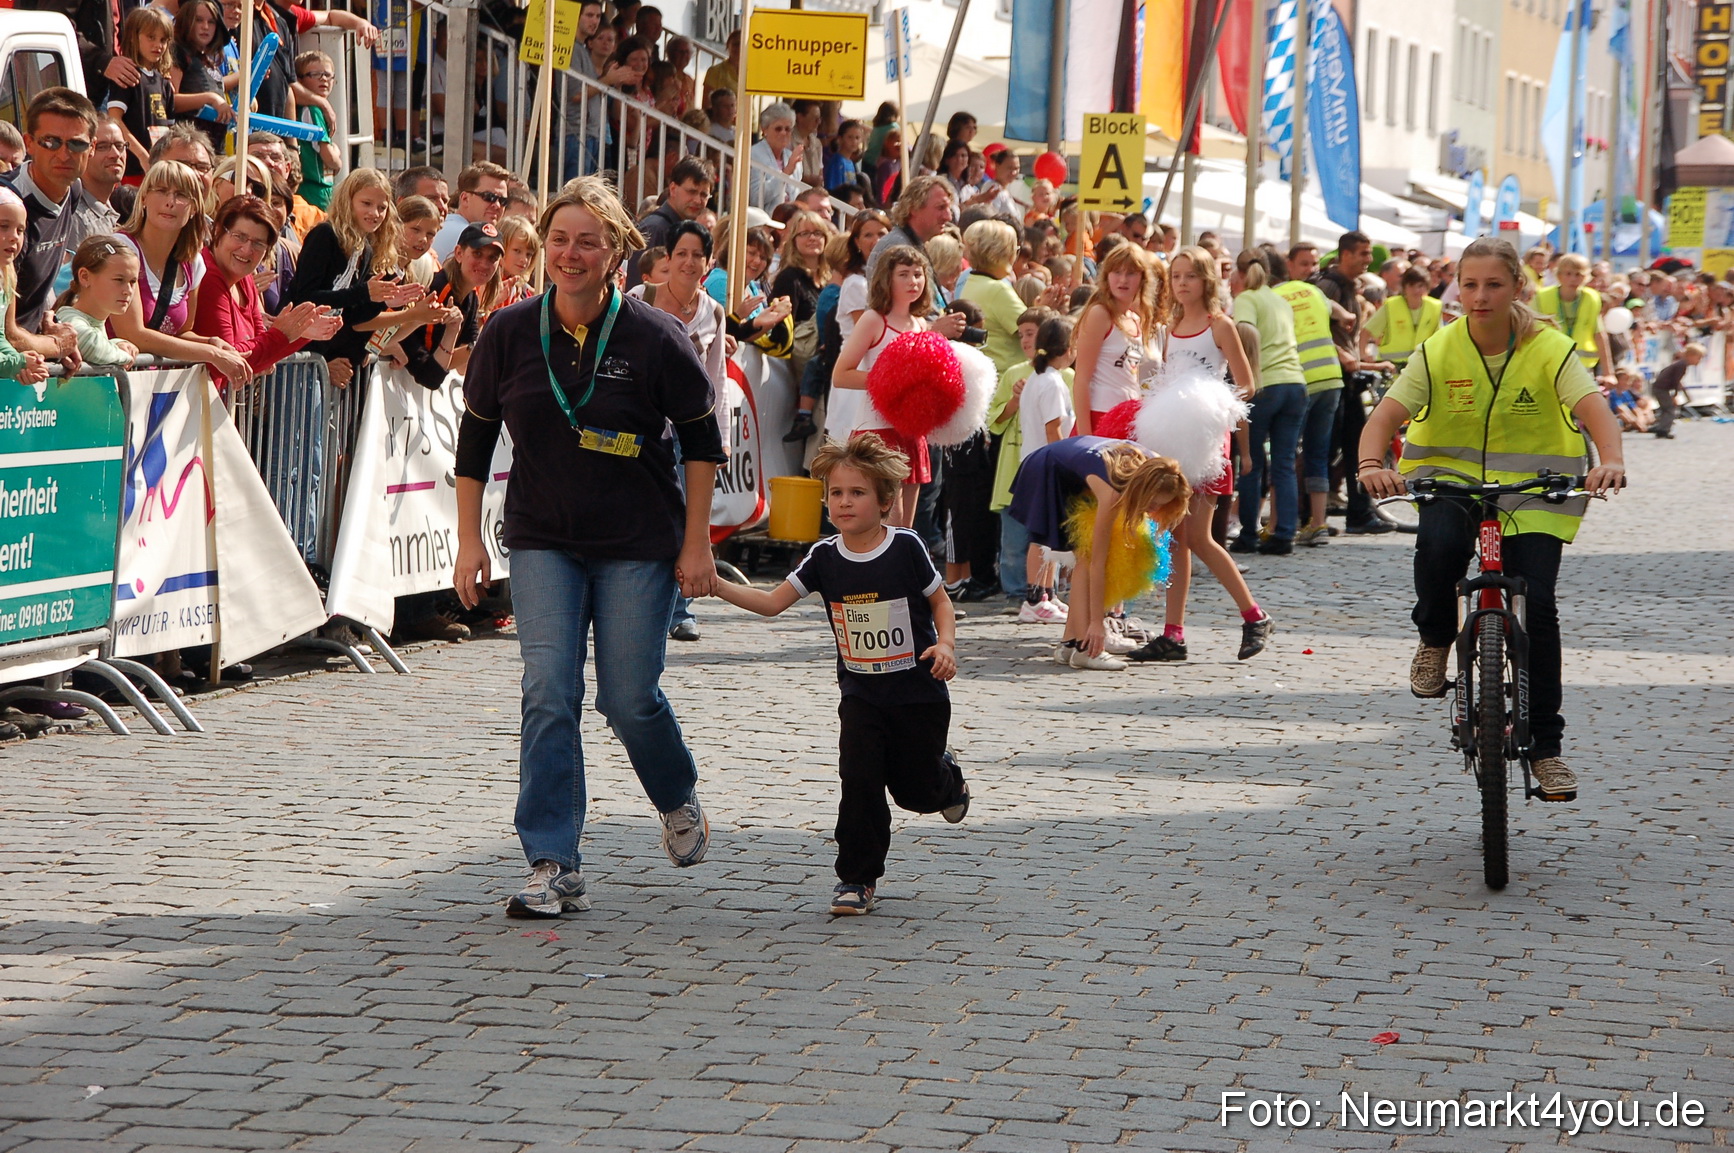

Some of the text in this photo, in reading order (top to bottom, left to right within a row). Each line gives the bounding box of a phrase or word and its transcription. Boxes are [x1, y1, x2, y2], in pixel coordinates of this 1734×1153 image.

[752, 33, 859, 57] Schnupper-
[787, 59, 822, 76] lauf
[1089, 117, 1139, 135] Block
[1092, 143, 1128, 190] A
[742, 414, 750, 440] &
[18, 602, 49, 630] 09181
[50, 598, 75, 624] 6352
[846, 608, 870, 623] Elias
[850, 627, 905, 651] 7000
